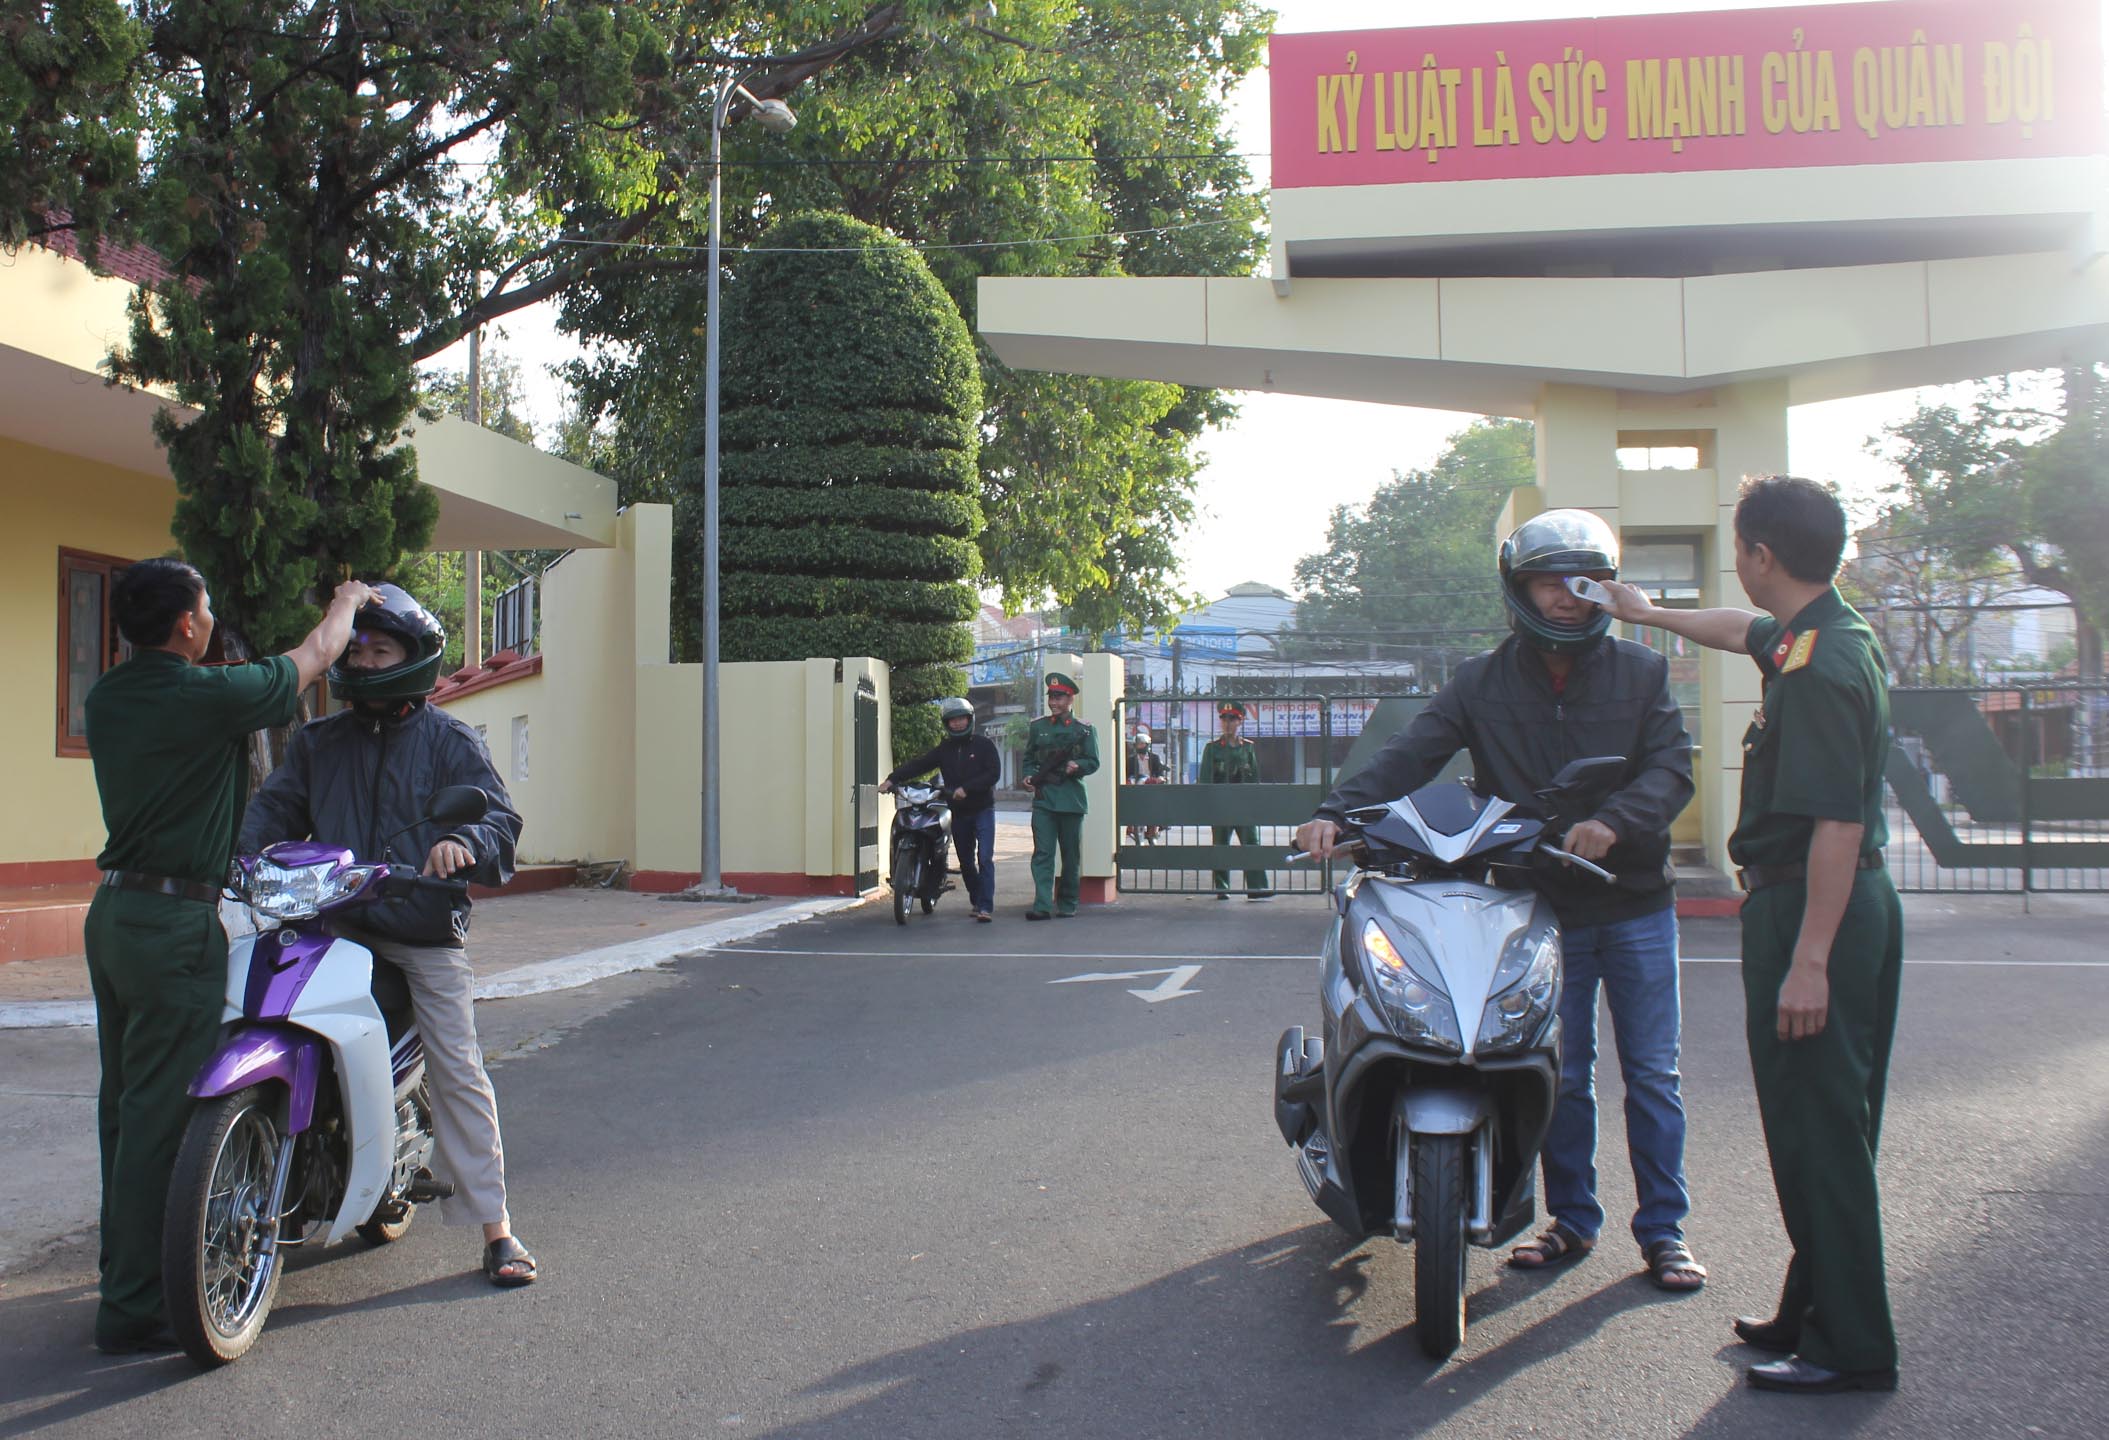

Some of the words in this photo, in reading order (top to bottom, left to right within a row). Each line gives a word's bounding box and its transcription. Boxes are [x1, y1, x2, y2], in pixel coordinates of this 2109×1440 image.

[1317, 50, 1364, 154] KỶ
[1374, 53, 1461, 164] LUẬT
[1472, 50, 1520, 147] LÀ
[1528, 46, 1608, 144] SỨC
[1626, 54, 1746, 154] MẠNH
[1761, 26, 1841, 134] CỦA
[1853, 28, 1965, 140] QUÂN
[1983, 21, 2055, 140] ĐỘI
